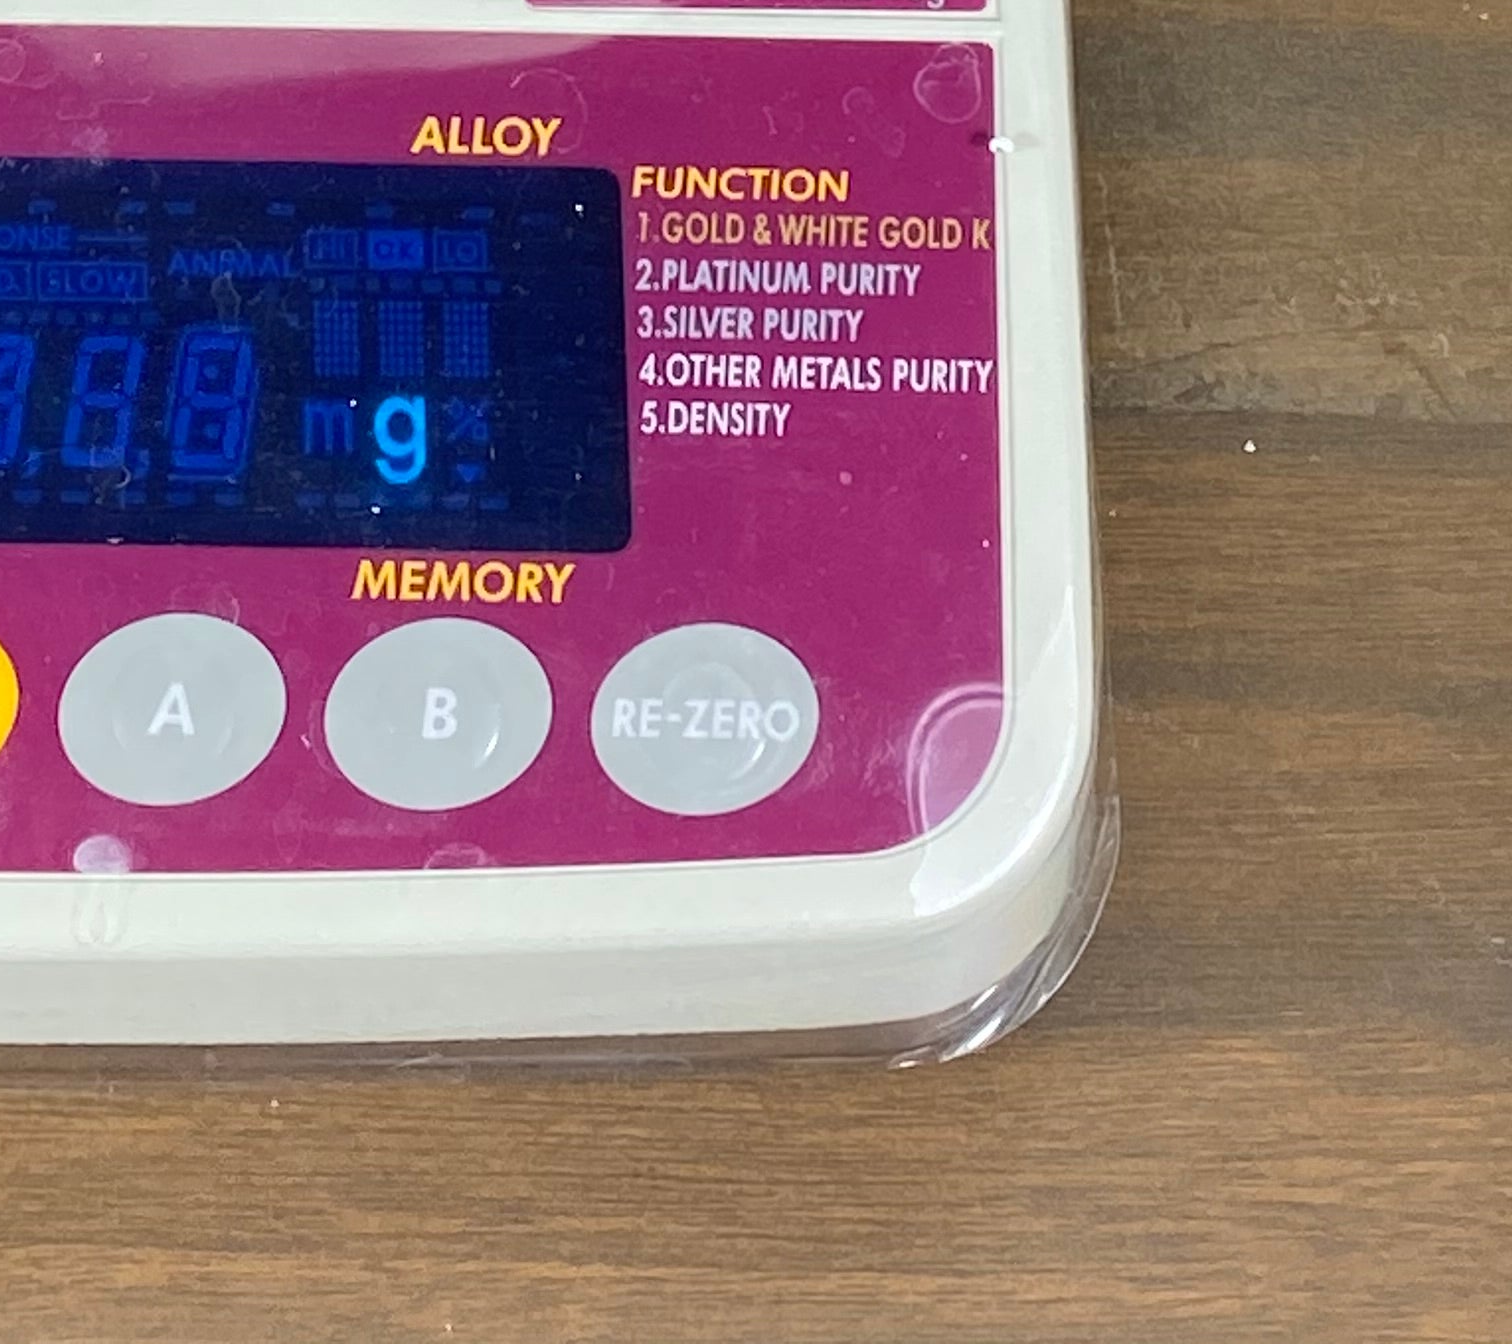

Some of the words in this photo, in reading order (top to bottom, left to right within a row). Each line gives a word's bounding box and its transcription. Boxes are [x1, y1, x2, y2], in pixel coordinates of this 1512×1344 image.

[409, 116, 563, 157] ALLOY
[632, 166, 849, 202] FUNCTION
[637, 212, 745, 245] 1.GOLD
[753, 215, 772, 245] &
[778, 216, 868, 248] WHITE
[879, 217, 962, 250] GOLD
[972, 219, 991, 250] K
[634, 258, 808, 293] 2.PLATINUM
[821, 262, 921, 296] PURITY
[637, 305, 754, 339] 3.SILVER
[763, 308, 863, 342] PURITY
[638, 352, 761, 388] 4.OTHER
[771, 356, 882, 391] METALS
[892, 359, 994, 393] PURITY
[640, 401, 791, 436] 5.DENSITY
[350, 560, 575, 603] MEMORY
[148, 682, 195, 737] A
[421, 688, 458, 739] B
[612, 699, 801, 742] RE-ZERO
